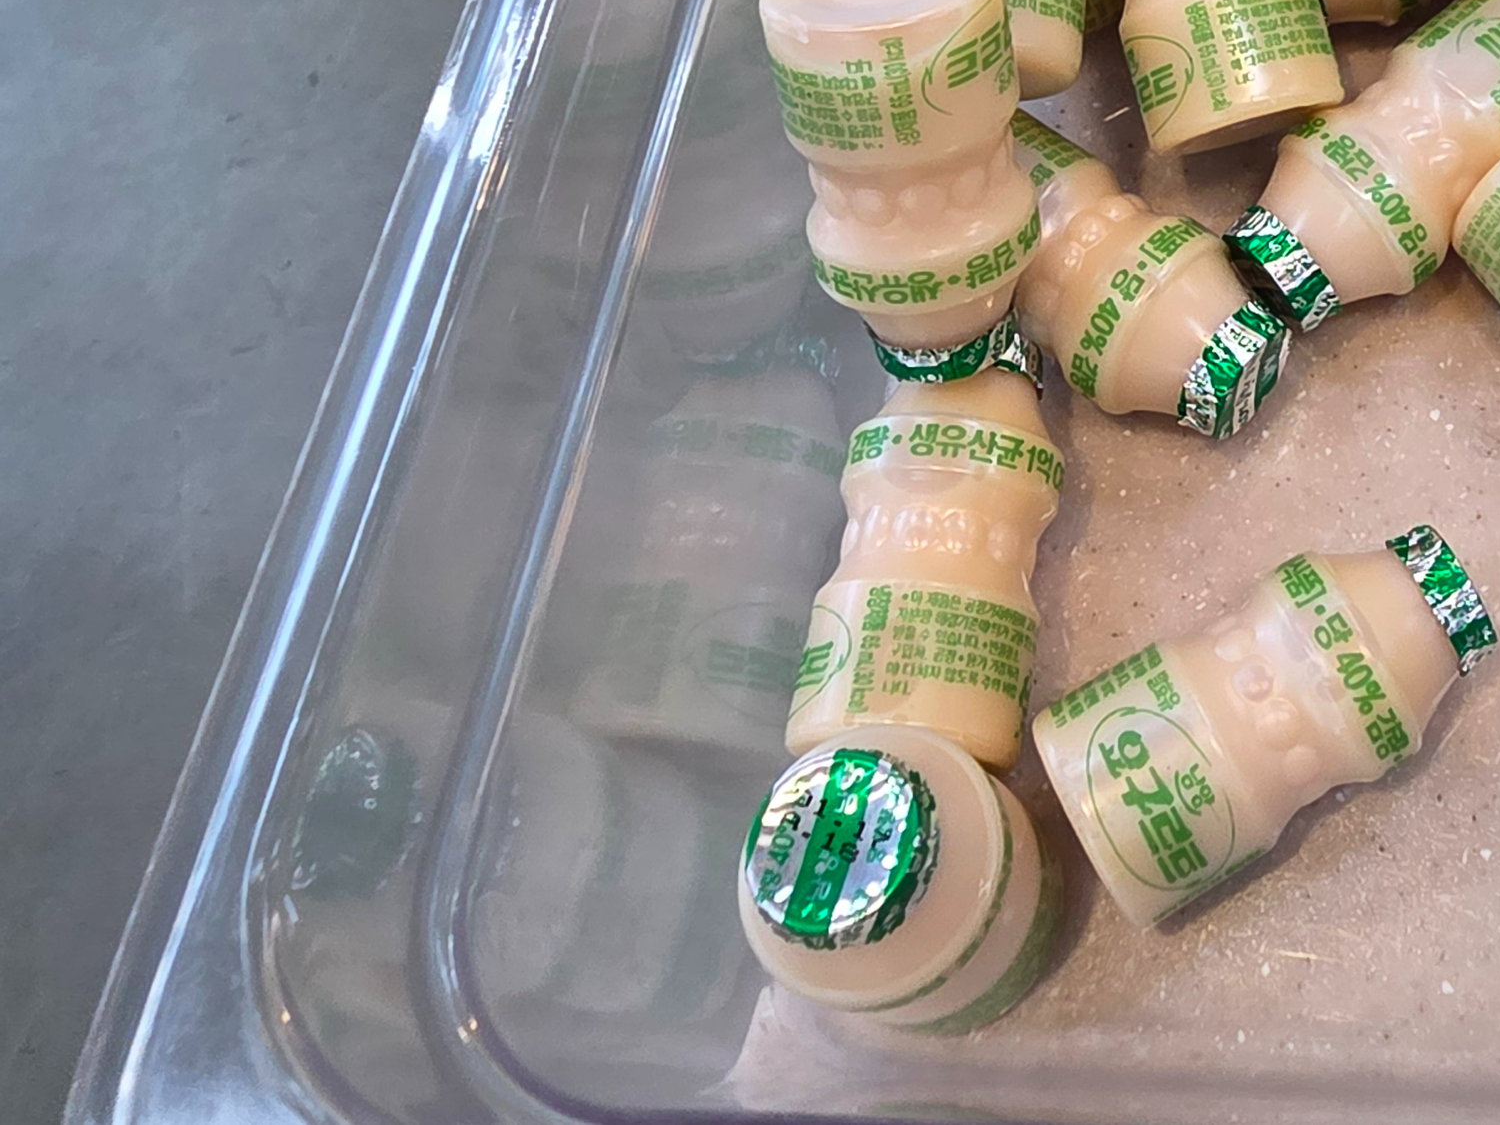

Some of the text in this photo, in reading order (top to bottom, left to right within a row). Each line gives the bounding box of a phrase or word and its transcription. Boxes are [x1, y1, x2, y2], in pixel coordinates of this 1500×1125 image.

[1365, 173, 1412, 227] 40%
[1110, 269, 1145, 302] 당
[1080, 297, 1121, 356] 40%
[850, 425, 890, 464] 감량
[909, 423, 1024, 470] 생유산균
[1313, 612, 1353, 650] 당
[1336, 653, 1386, 715] 40%
[1365, 707, 1410, 761] 감량
[1099, 730, 1208, 884] 요구르트
